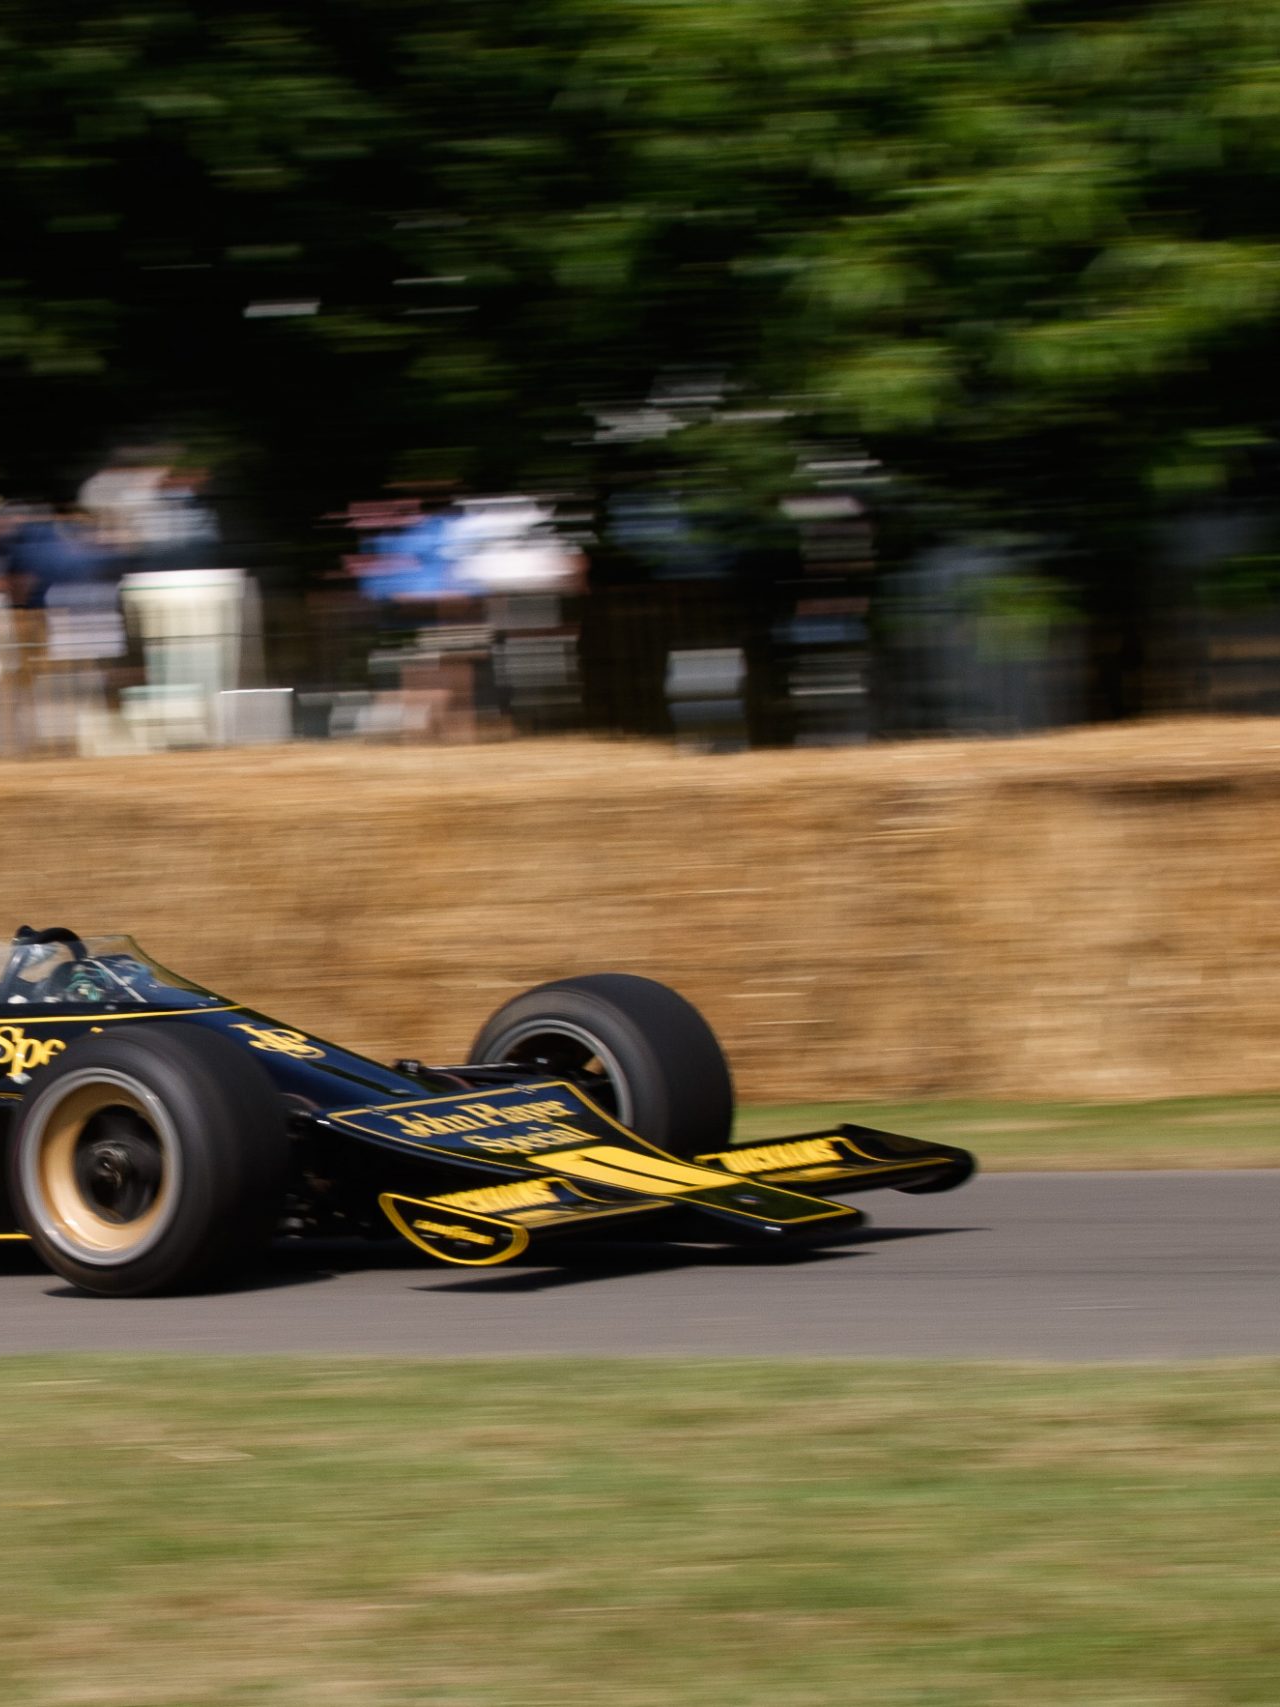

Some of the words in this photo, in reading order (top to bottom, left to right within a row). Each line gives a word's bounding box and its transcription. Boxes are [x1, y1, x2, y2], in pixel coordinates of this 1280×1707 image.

[386, 1111, 492, 1138] John
[454, 1100, 578, 1127] Player
[462, 1122, 604, 1155] Special
